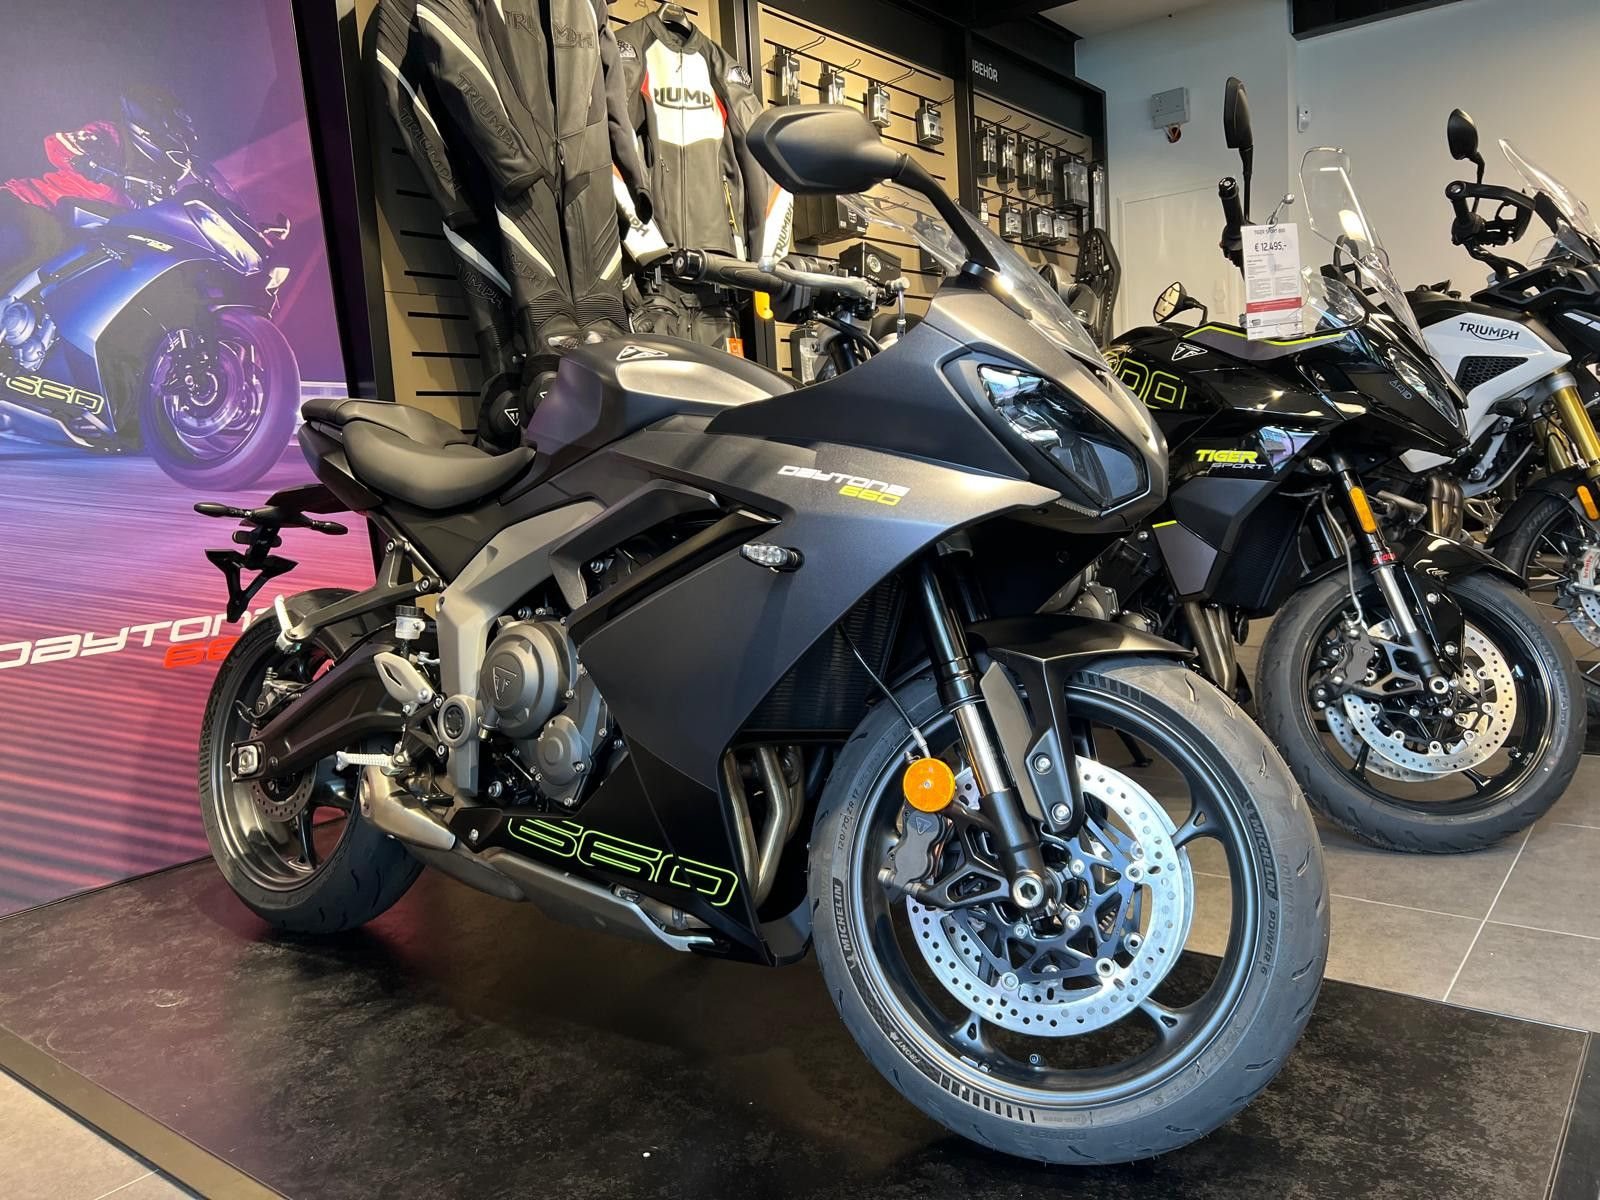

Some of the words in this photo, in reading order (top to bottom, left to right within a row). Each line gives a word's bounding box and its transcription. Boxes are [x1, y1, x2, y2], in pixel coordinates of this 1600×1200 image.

[1459, 321, 1520, 341] TRIUMPH
[1195, 449, 1258, 464] TIGER
[1211, 462, 1267, 470] SPORT
[777, 465, 911, 497] DAYTONA
[838, 485, 902, 506] 660
[0, 607, 272, 670] DAYTON
[507, 817, 739, 906] 660
[1252, 815, 1278, 900] MICHELIN
[833, 884, 851, 951] MICHELIN
[1264, 910, 1276, 963] POWER
